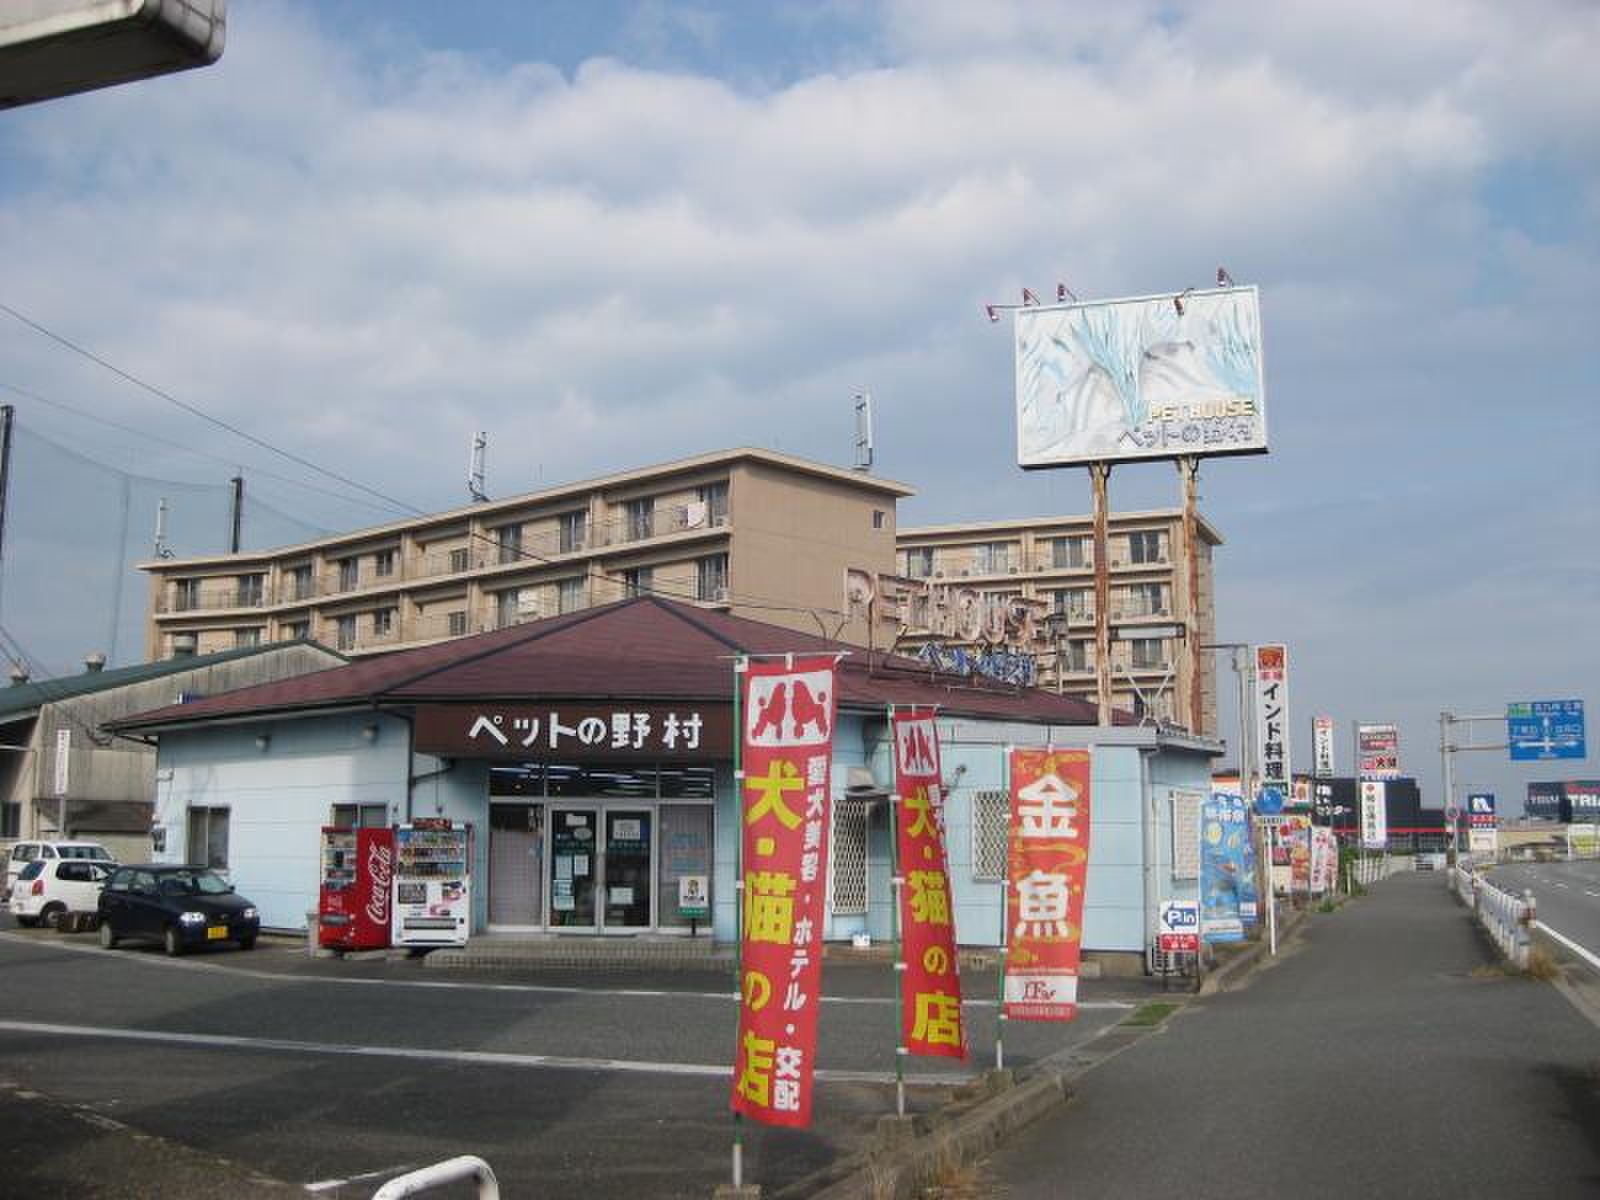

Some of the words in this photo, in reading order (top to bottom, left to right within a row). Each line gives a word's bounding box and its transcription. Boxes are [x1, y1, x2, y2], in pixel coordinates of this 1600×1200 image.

[468, 712, 703, 750] ペットの野村
[1264, 683, 1284, 780] インド料理
[1014, 773, 1079, 939] 金魚
